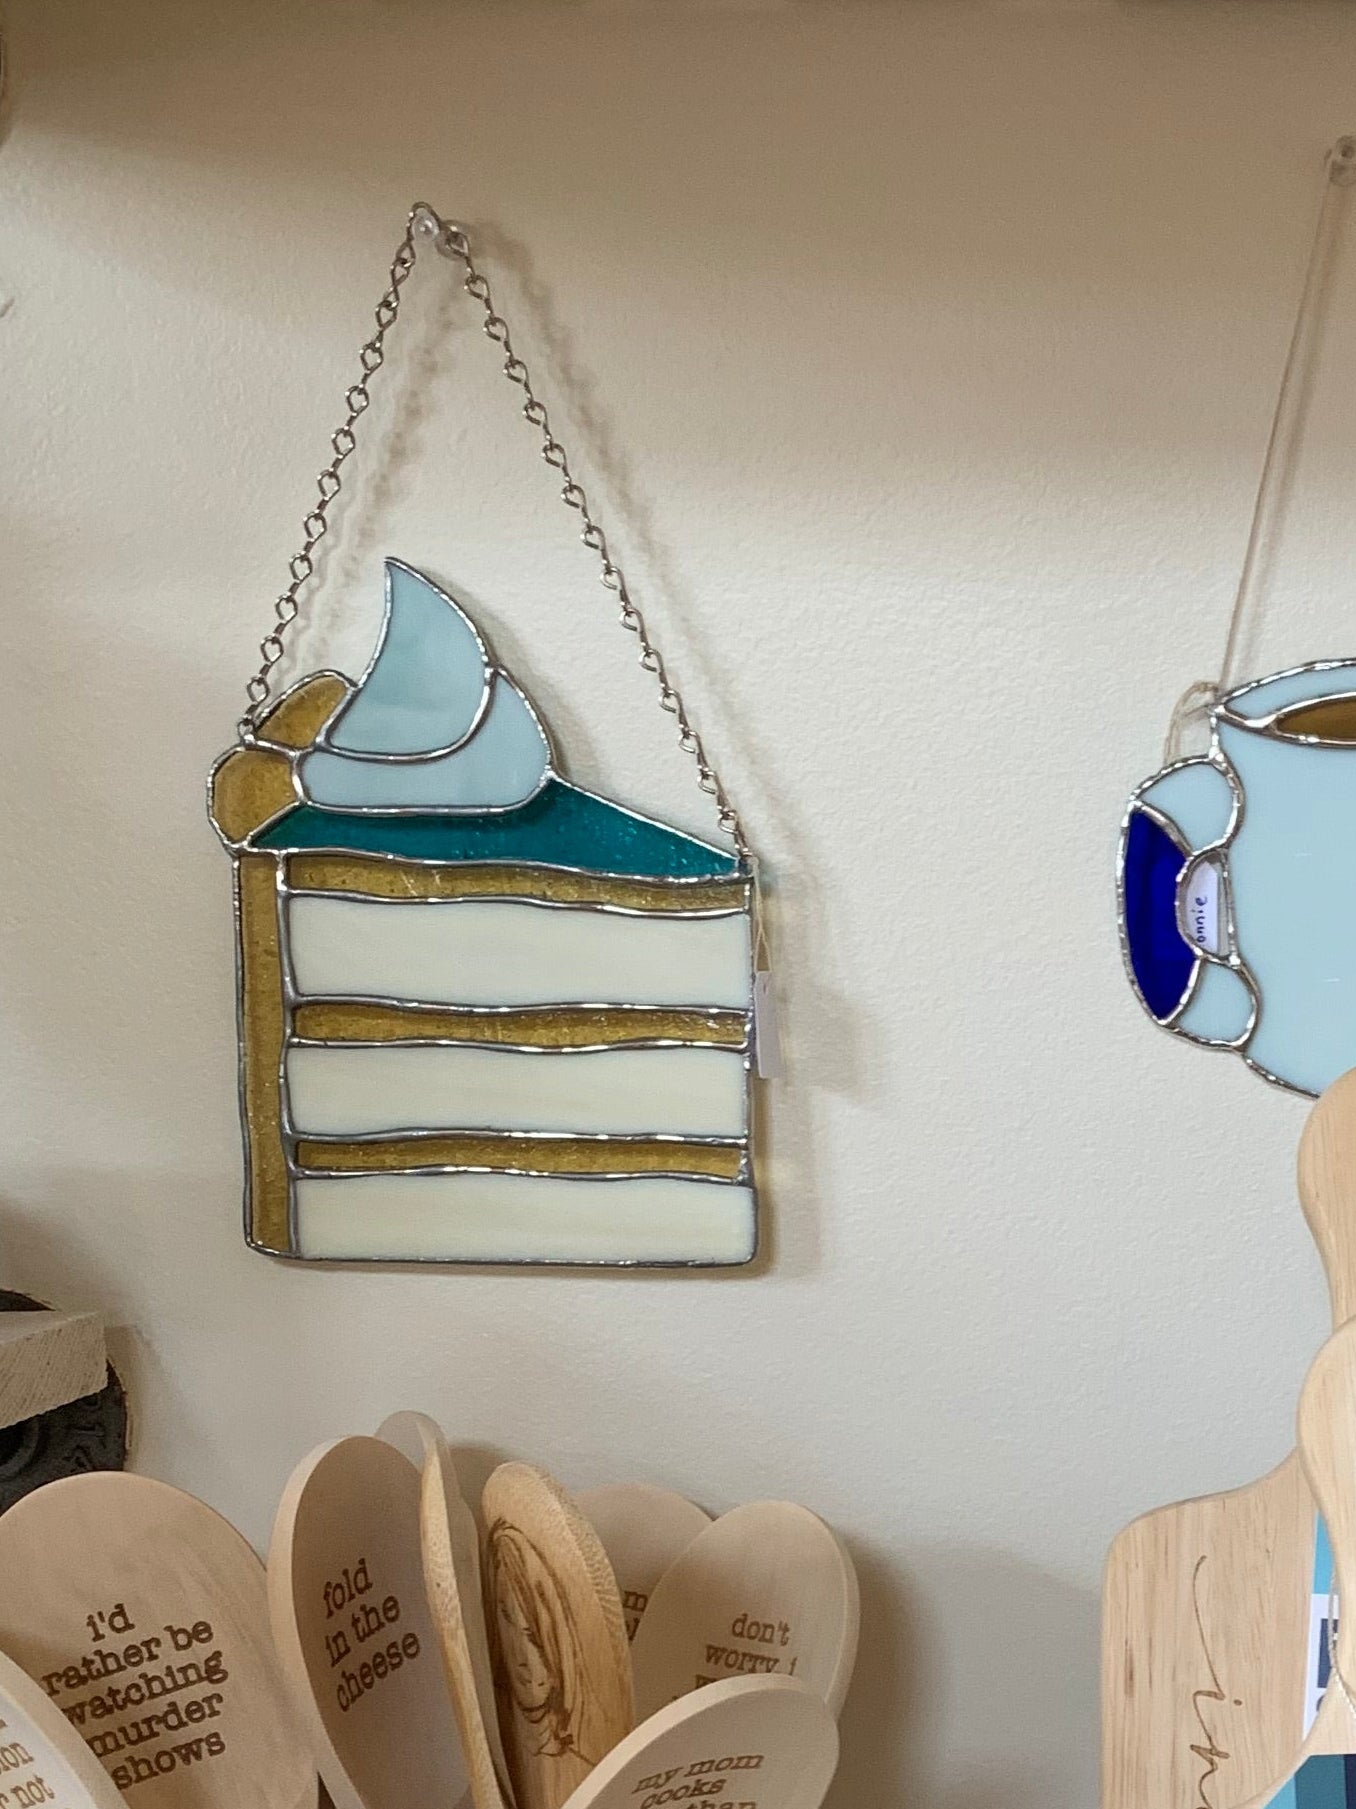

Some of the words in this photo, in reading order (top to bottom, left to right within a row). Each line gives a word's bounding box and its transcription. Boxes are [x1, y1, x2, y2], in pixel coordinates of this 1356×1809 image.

[323, 1557, 373, 1619] fold
[86, 1603, 136, 1642] i'd
[324, 1630, 350, 1668] in
[351, 1595, 400, 1643] the
[731, 1612, 790, 1647] don't
[41, 1637, 162, 1696] rather
[163, 1620, 214, 1651] be
[336, 1633, 421, 1712] cheese
[61, 1651, 229, 1727] watching
[85, 1692, 224, 1757] murder
[109, 1731, 226, 1790] shows
[632, 1766, 684, 1794] my
[684, 1754, 765, 1778] mom
[11, 1774, 55, 1809] not
[640, 1778, 727, 1809] cooks
